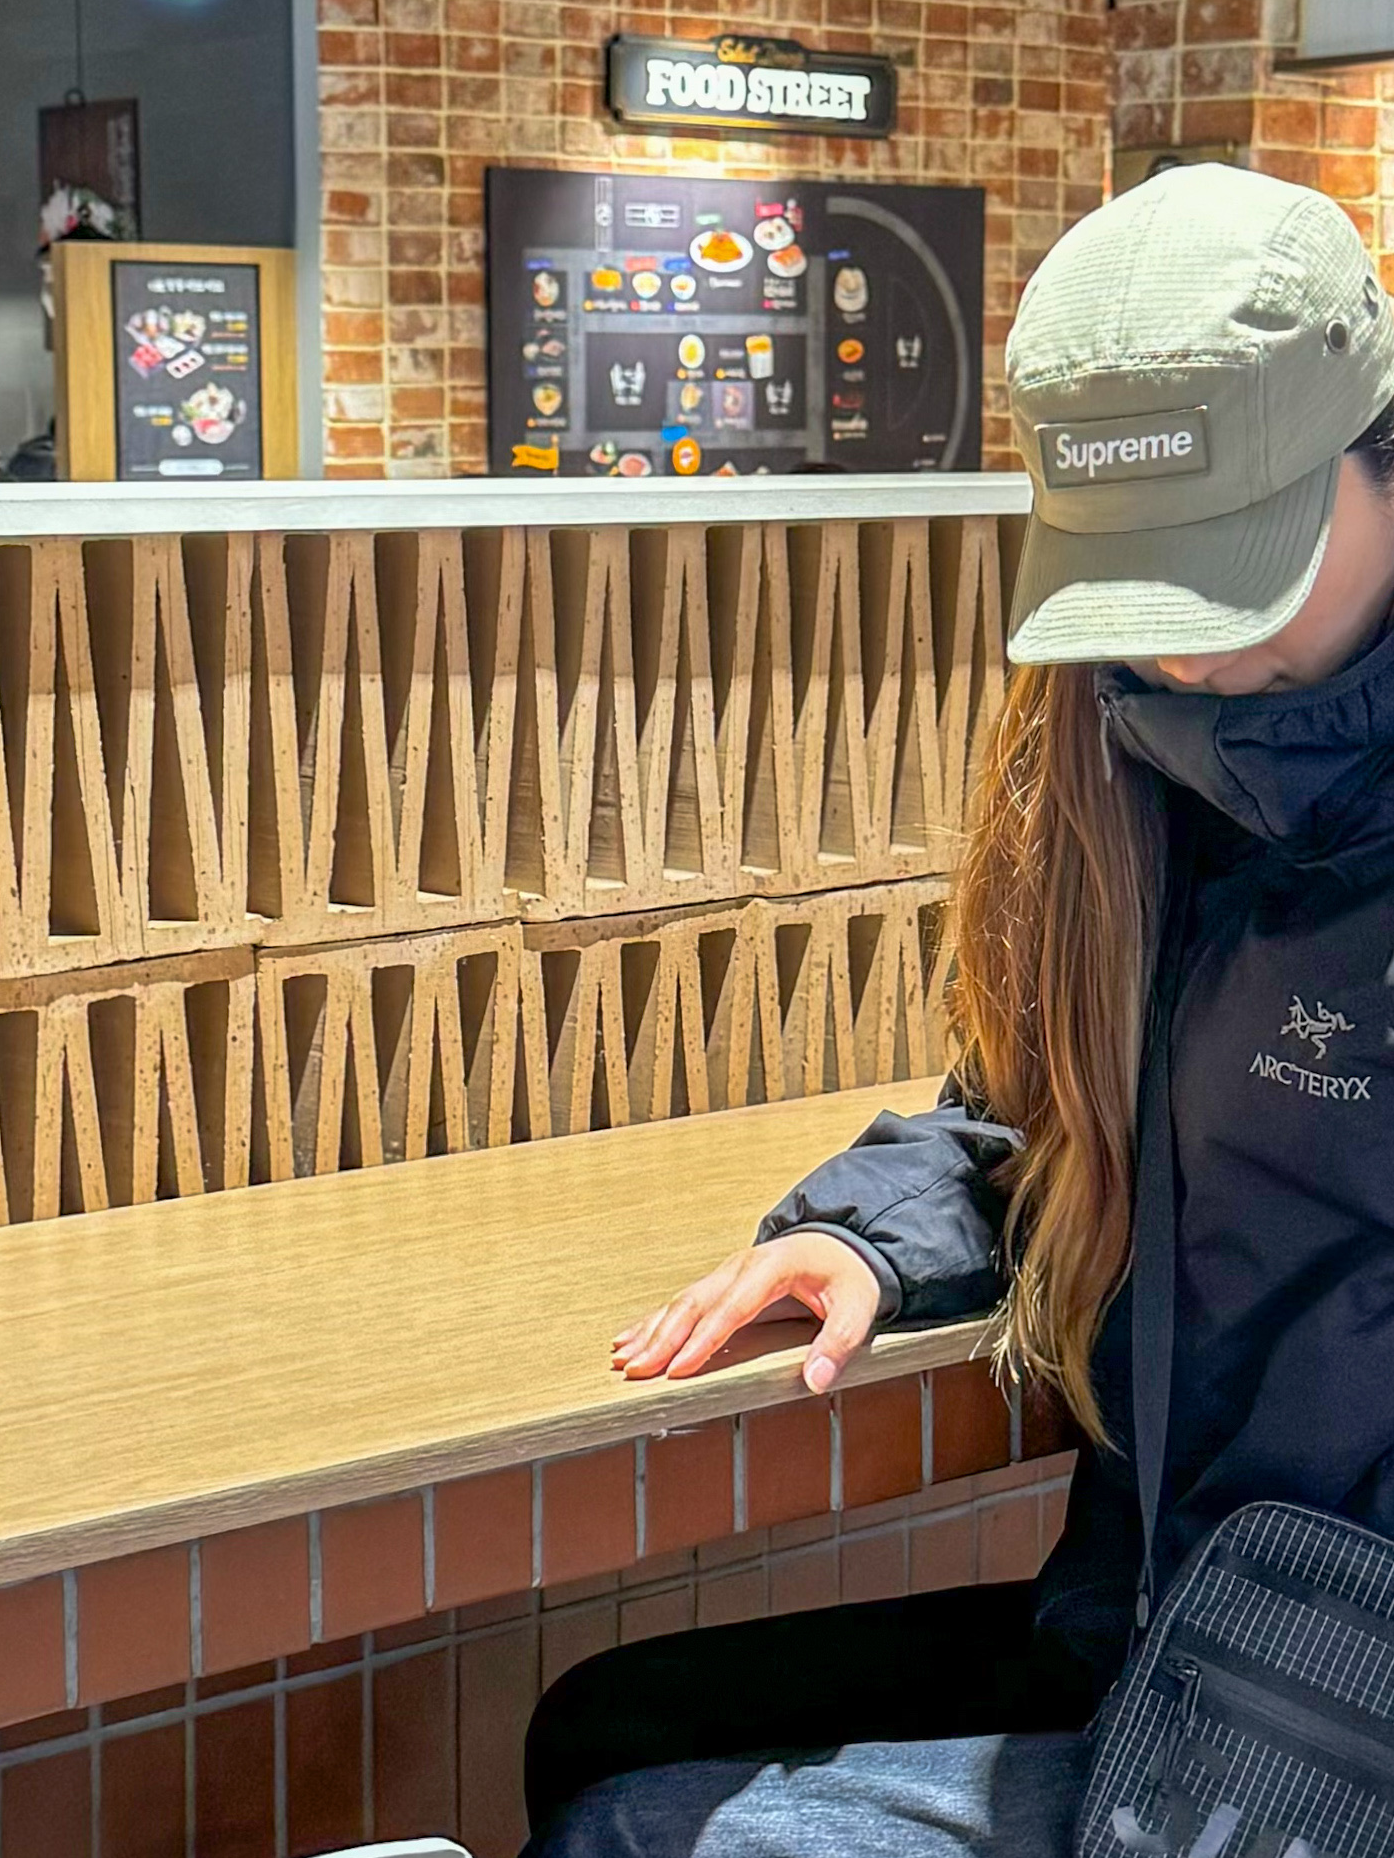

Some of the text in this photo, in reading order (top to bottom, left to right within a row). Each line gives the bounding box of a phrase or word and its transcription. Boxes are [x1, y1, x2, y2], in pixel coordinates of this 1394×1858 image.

[646, 59, 871, 120] FOOD STREET
[1056, 431, 1193, 478] Supreme
